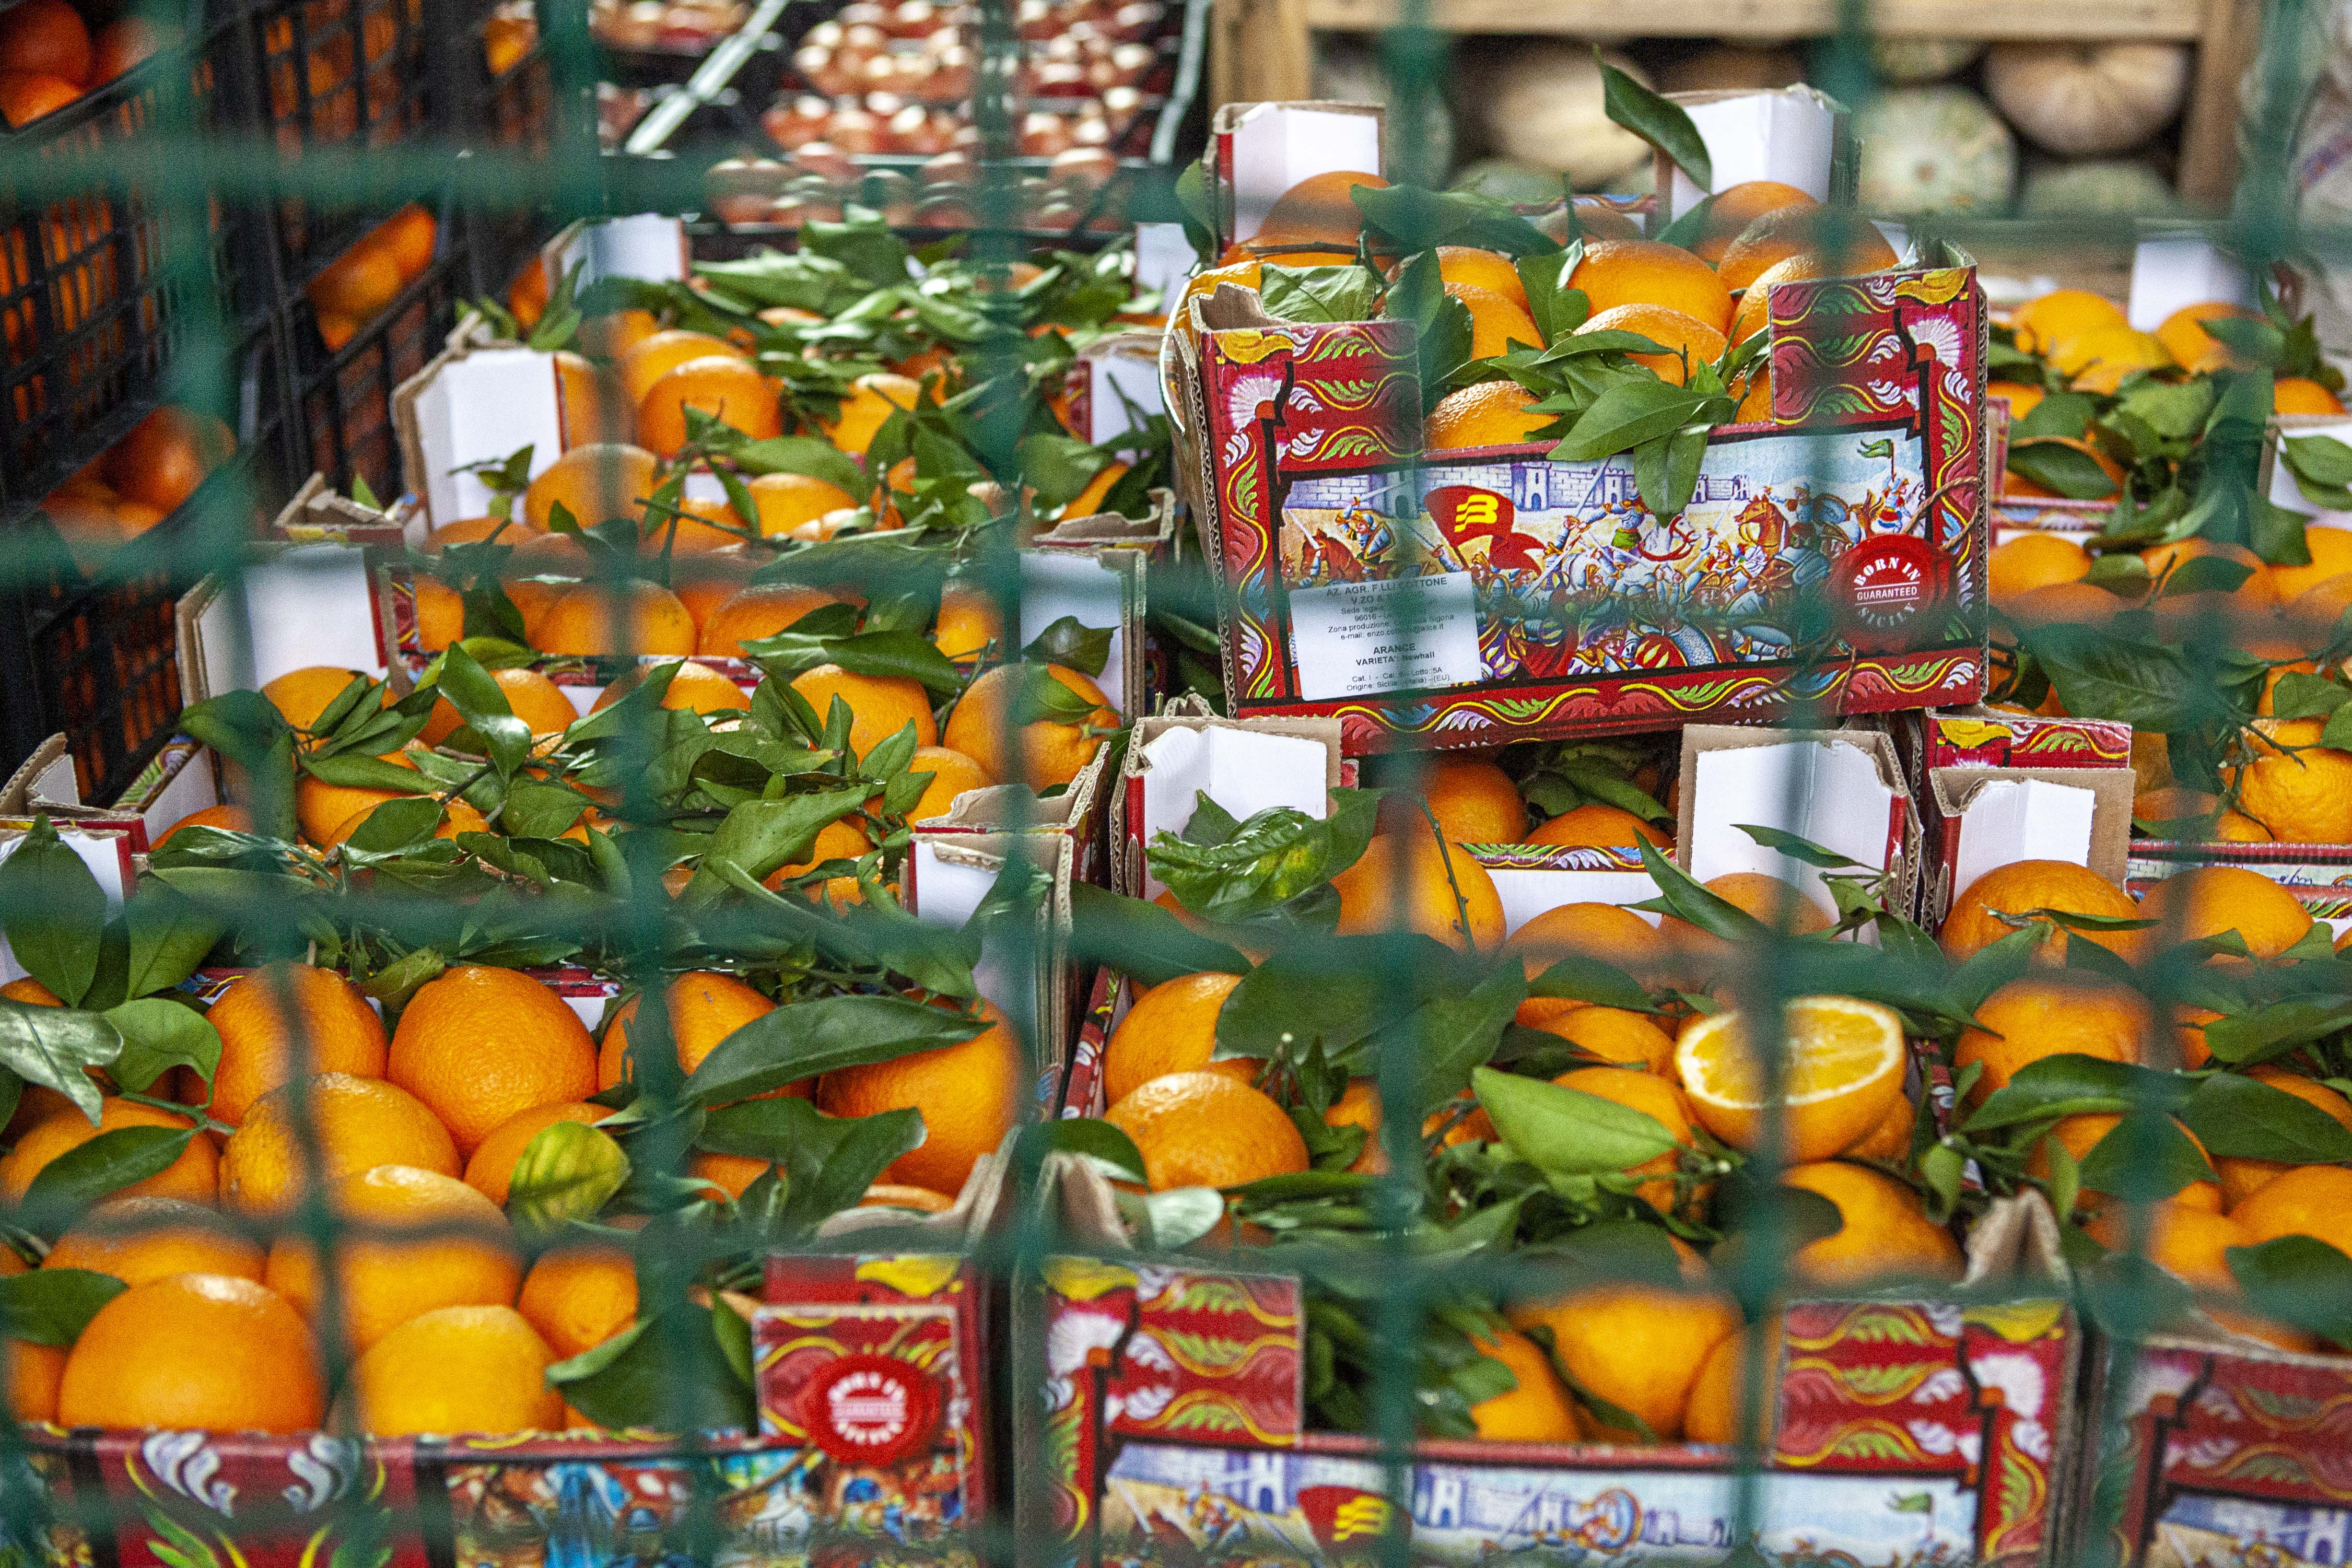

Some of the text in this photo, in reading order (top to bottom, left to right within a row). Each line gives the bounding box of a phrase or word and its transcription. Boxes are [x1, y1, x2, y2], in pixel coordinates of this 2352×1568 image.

[1853, 557, 1921, 586] BORN IN
[1345, 586, 1369, 595] AGR.
[1857, 586, 1918, 601] GUARANTEED
[1858, 602, 1916, 627] SICILY
[1373, 643, 1416, 655] ARANCE
[1346, 683, 1374, 691] Origine:
[1433, 674, 1450, 682] (EU)
